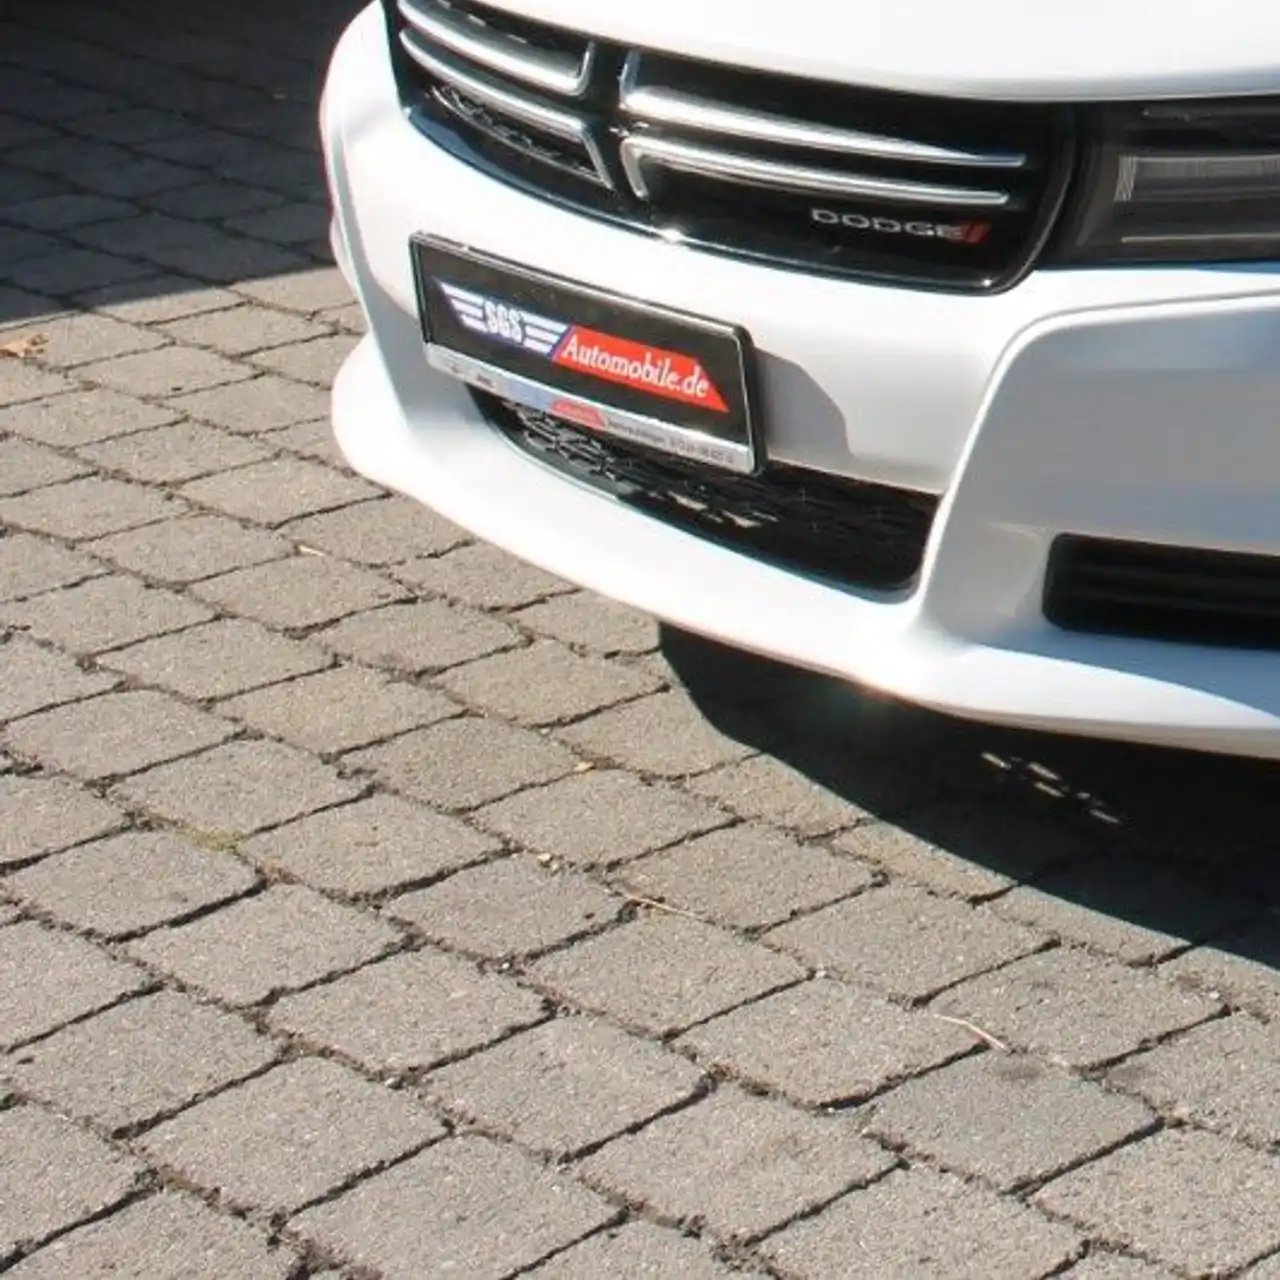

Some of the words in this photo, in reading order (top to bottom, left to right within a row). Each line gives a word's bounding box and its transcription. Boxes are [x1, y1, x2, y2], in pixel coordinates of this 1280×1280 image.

[811, 208, 965, 241] DODGE
[483, 296, 525, 345] SGS
[560, 333, 711, 399] Automobile.de
